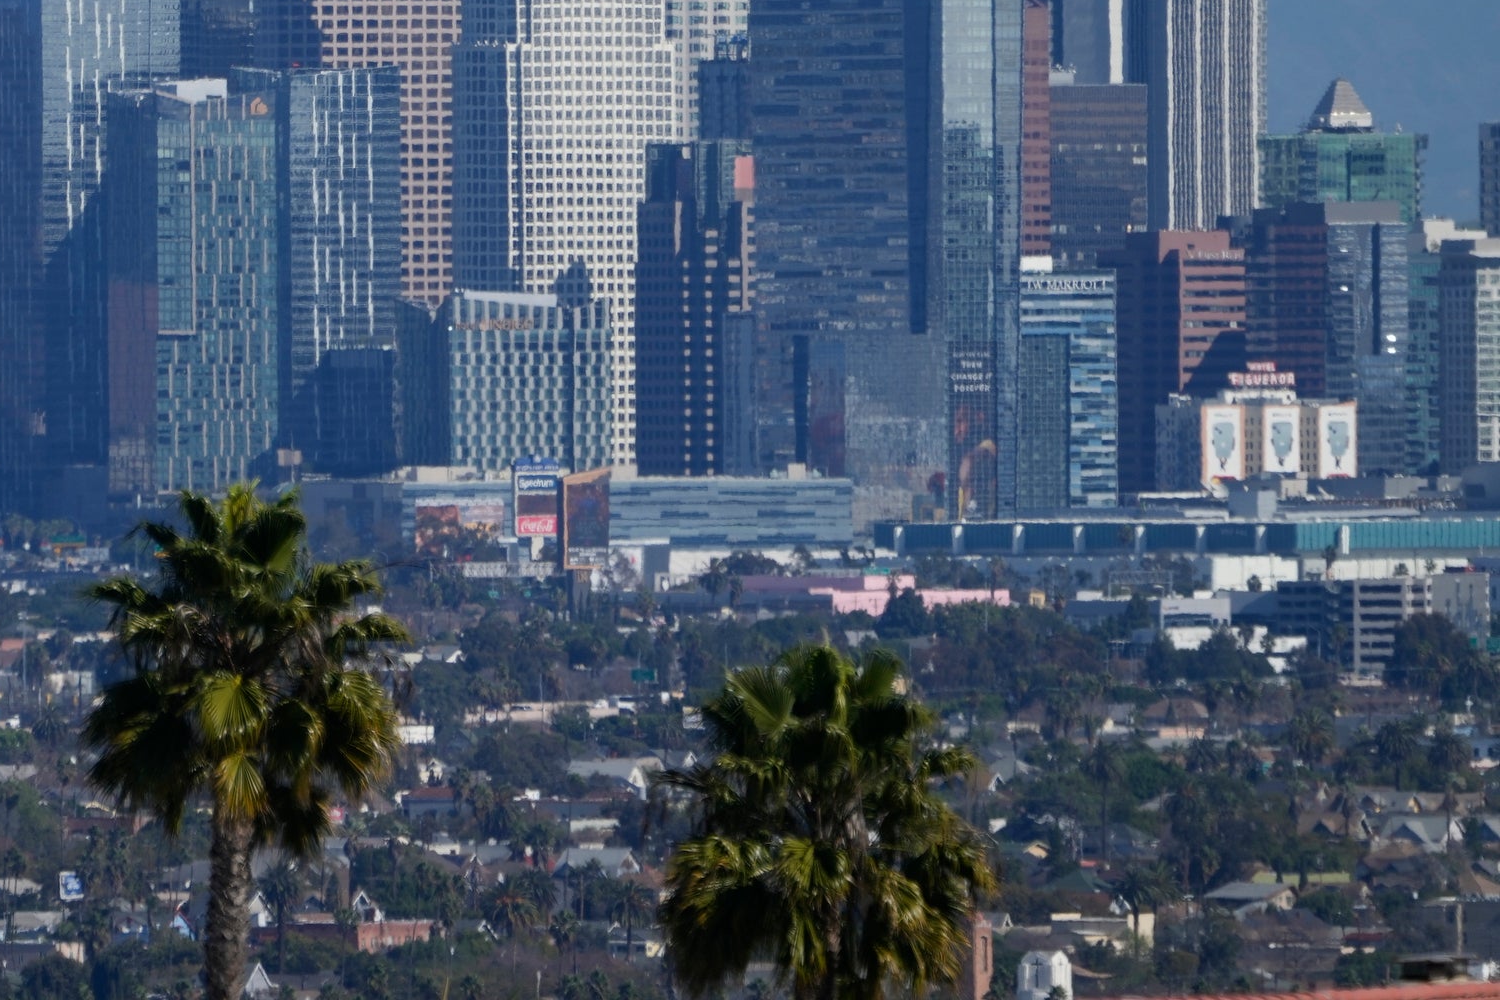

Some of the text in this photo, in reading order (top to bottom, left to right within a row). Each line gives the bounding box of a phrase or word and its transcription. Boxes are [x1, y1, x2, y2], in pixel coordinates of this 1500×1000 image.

[1246, 362, 1276, 372] HOTEL
[1228, 372, 1296, 385] FIGUEROA
[519, 479, 554, 490] Spectrum
